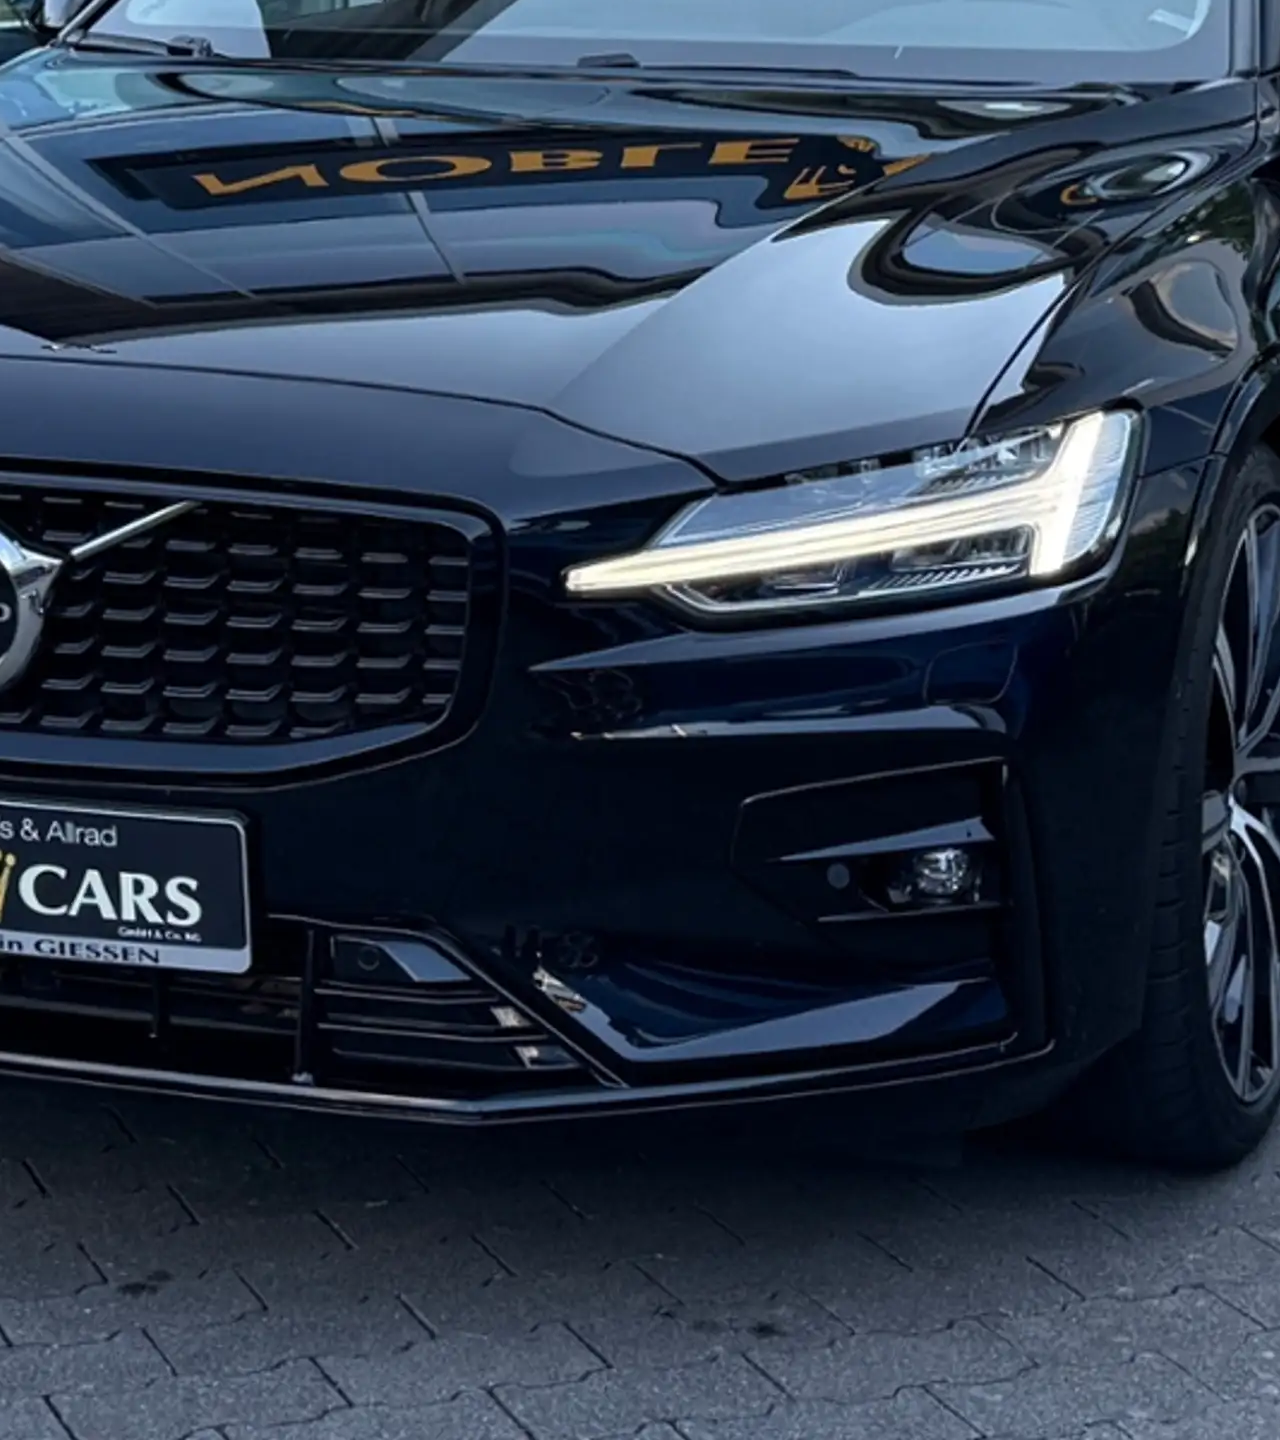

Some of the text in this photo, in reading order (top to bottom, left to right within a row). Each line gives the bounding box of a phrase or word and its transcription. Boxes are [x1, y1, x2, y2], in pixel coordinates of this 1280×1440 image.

[20, 817, 40, 842] &
[46, 820, 118, 847] Allrad
[18, 864, 202, 927] CARS
[34, 938, 161, 964] GIESSEN
